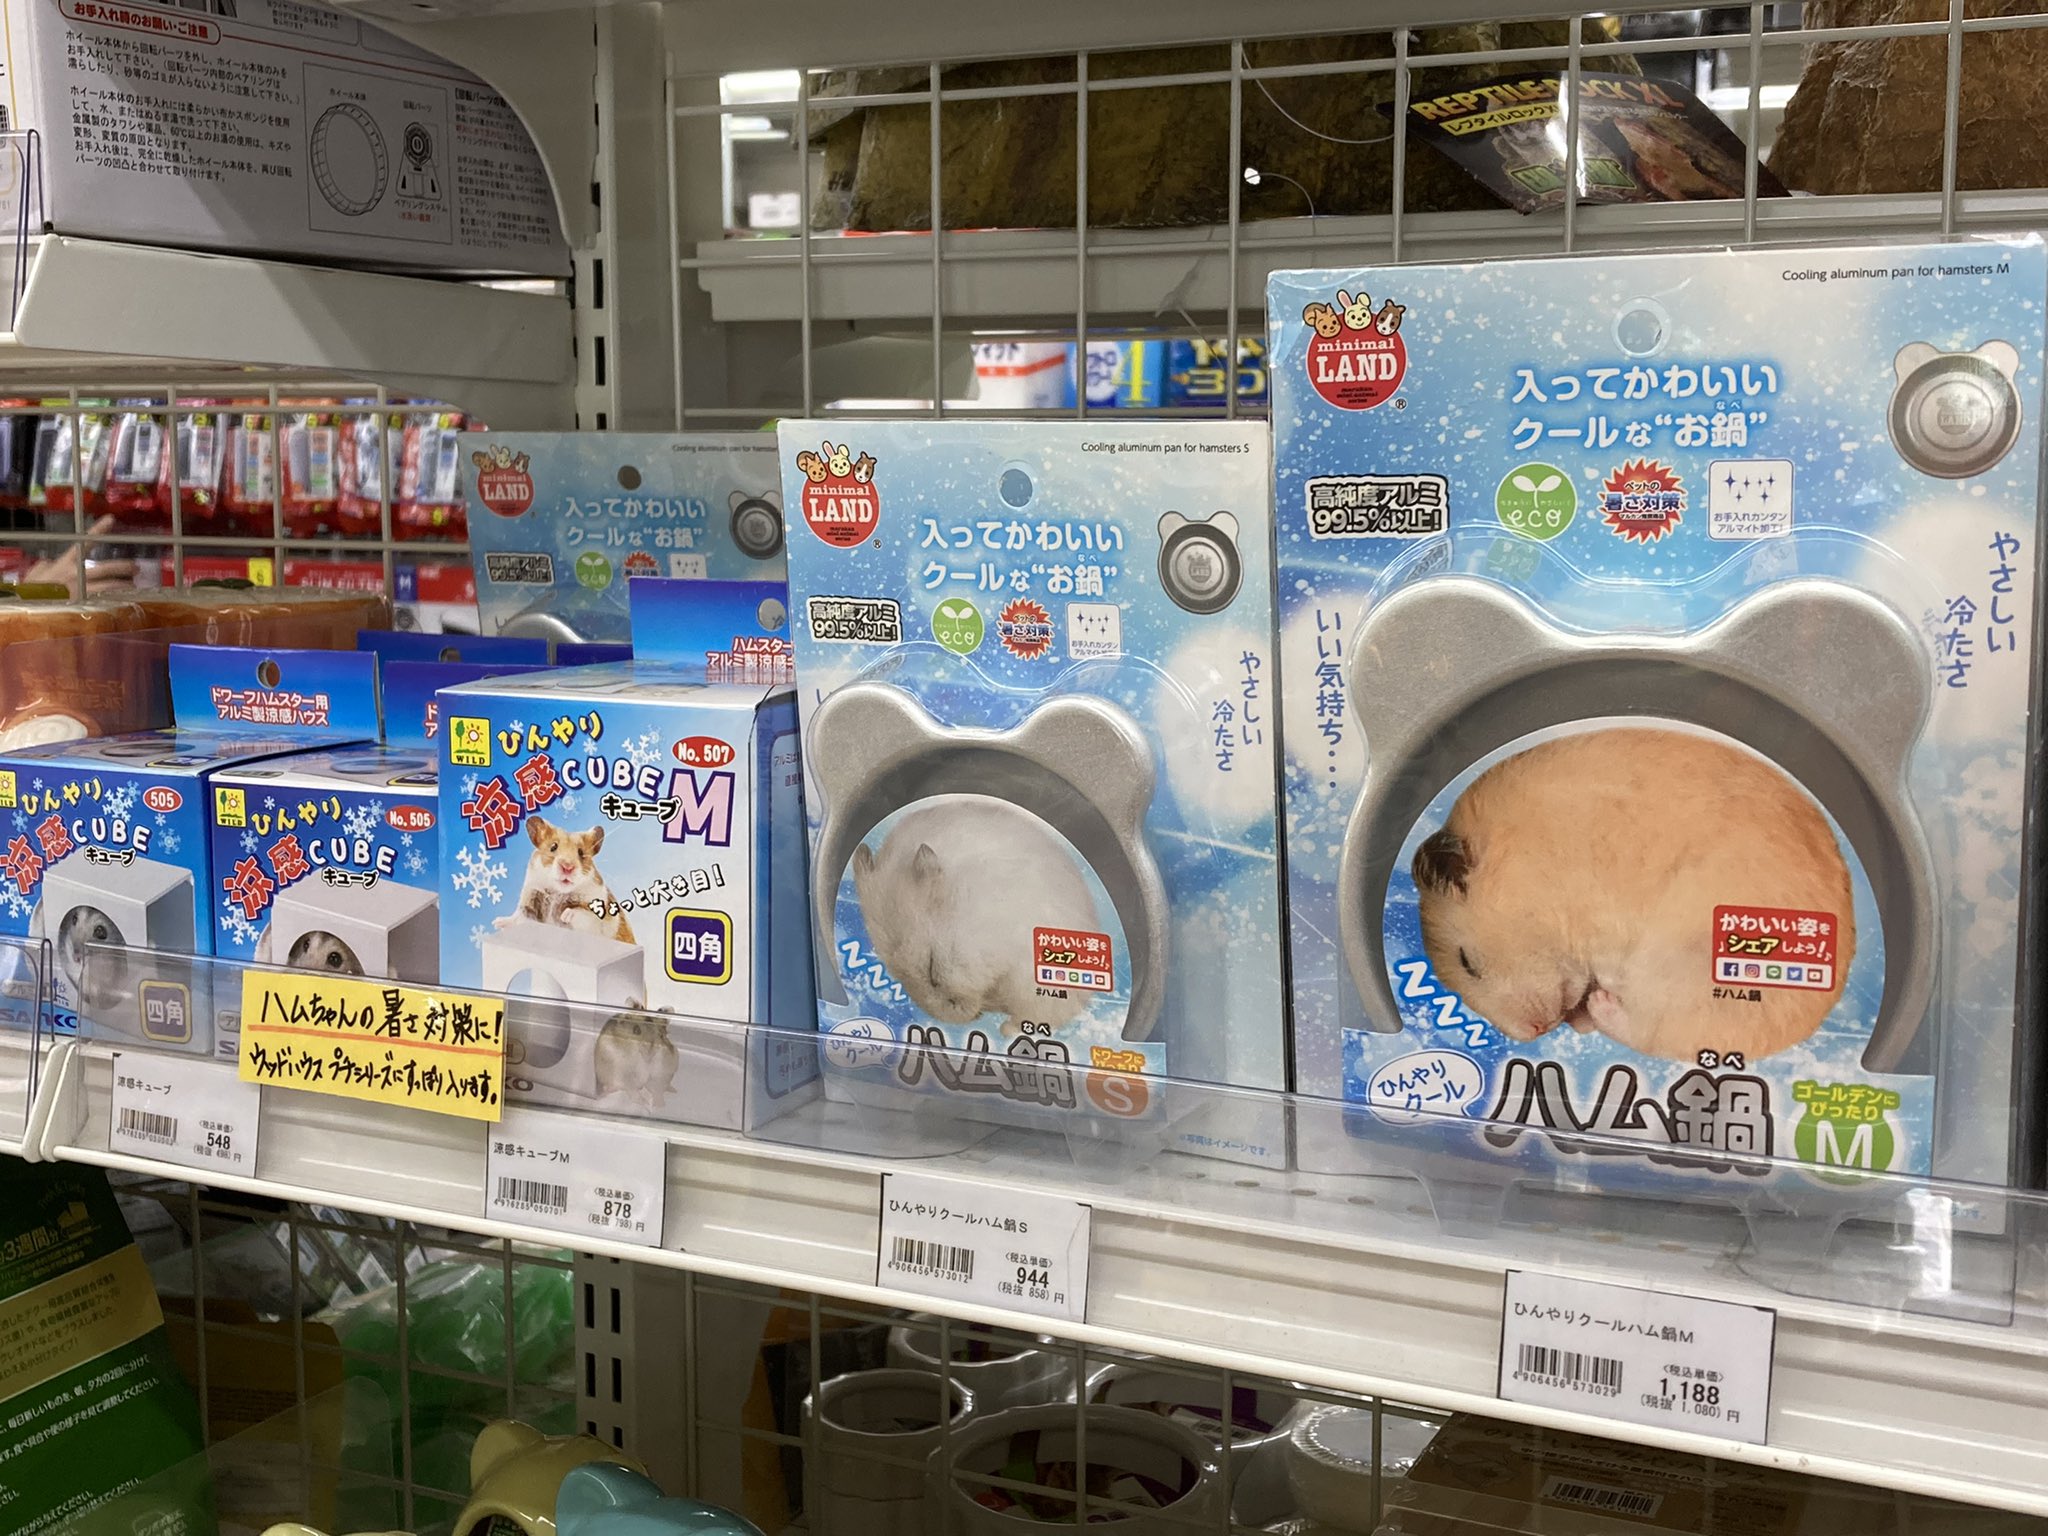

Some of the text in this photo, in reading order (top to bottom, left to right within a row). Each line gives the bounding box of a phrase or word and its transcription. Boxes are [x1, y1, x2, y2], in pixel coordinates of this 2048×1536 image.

[1410, 80, 1552, 120] REPTILE
[1782, 263, 2010, 282] Cooling aluminum pan for hamsters M
[1317, 337, 1395, 352] minimal
[1316, 352, 1398, 383] LAND
[1512, 364, 1777, 404] 入ってかわいい
[1081, 442, 1250, 454] Cooling aluminum pan for hamsters S
[483, 483, 530, 501] LAND
[809, 484, 871, 496] minimal
[1311, 482, 1441, 509] 高純度アルミ
[1624, 481, 1660, 491] ペットの
[565, 497, 706, 519] 入ってかわいい
[809, 498, 874, 524] LAND
[1604, 493, 1681, 512] 暑さ対策
[1507, 509, 1562, 528] eco
[1713, 512, 1788, 522] お手入れカンタン
[921, 518, 1124, 552] 入ってかわいい
[1988, 531, 2021, 653] やさしい
[811, 602, 896, 621] 高純度アルミ
[939, 631, 975, 646] eco
[1002, 625, 1050, 637] 暑さ対策
[1943, 595, 1977, 688] 冷たさ
[210, 687, 329, 710] ドワーフハムスター用
[1240, 651, 1262, 745] やさしい
[217, 704, 329, 727] アルミ製涼感ハウス
[497, 711, 604, 756] ひんやり
[1212, 699, 1235, 771] 冷たさ
[455, 755, 487, 765] WILD
[677, 740, 730, 763] No. 507
[561, 757, 662, 797] CUBE
[22, 776, 103, 816] ひんやり
[150, 791, 175, 808] 505
[251, 796, 342, 836] ひんやり
[600, 792, 681, 824] キューブ
[662, 768, 736, 848] M
[219, 817, 244, 826] WILD
[389, 812, 431, 827] No. 505
[72, 818, 150, 851] CUBE
[85, 847, 136, 867] キューブ
[308, 838, 397, 874] CUBE
[322, 868, 379, 889] キューブ
[1719, 913, 1831, 938] かわいい姿を
[674, 931, 723, 965] 四角
[1038, 933, 1107, 952] かわいい姿を
[146, 999, 185, 1026] 四角
[1021, 1020, 1051, 1036] なべ
[1091, 1048, 1146, 1066] ドワーフに
[1699, 1050, 1745, 1069] なべ
[117, 1076, 172, 1095] 涼感キューブ
[1377, 1060, 1446, 1097] ひんやり
[1102, 1077, 1133, 1112] S
[1795, 1083, 1898, 1107] ゴールデンに
[1484, 1058, 1774, 1176] ハム鍋
[207, 1132, 231, 1150] 548
[1816, 1119, 1873, 1173] M
[233, 1153, 242, 1163] 円
[493, 1142, 570, 1164] 涼感キューブM
[603, 1201, 632, 1219] 878
[889, 1199, 1028, 1234] ひんやりクールハム鍋S
[635, 1221, 645, 1232] 円
[1016, 1267, 1049, 1289] 944
[1054, 1292, 1065, 1304] 円
[1513, 1302, 1694, 1344] ひんやりクールハム鍋M
[1659, 1377, 1720, 1405] 1,188
[1726, 1410, 1741, 1423] 円
